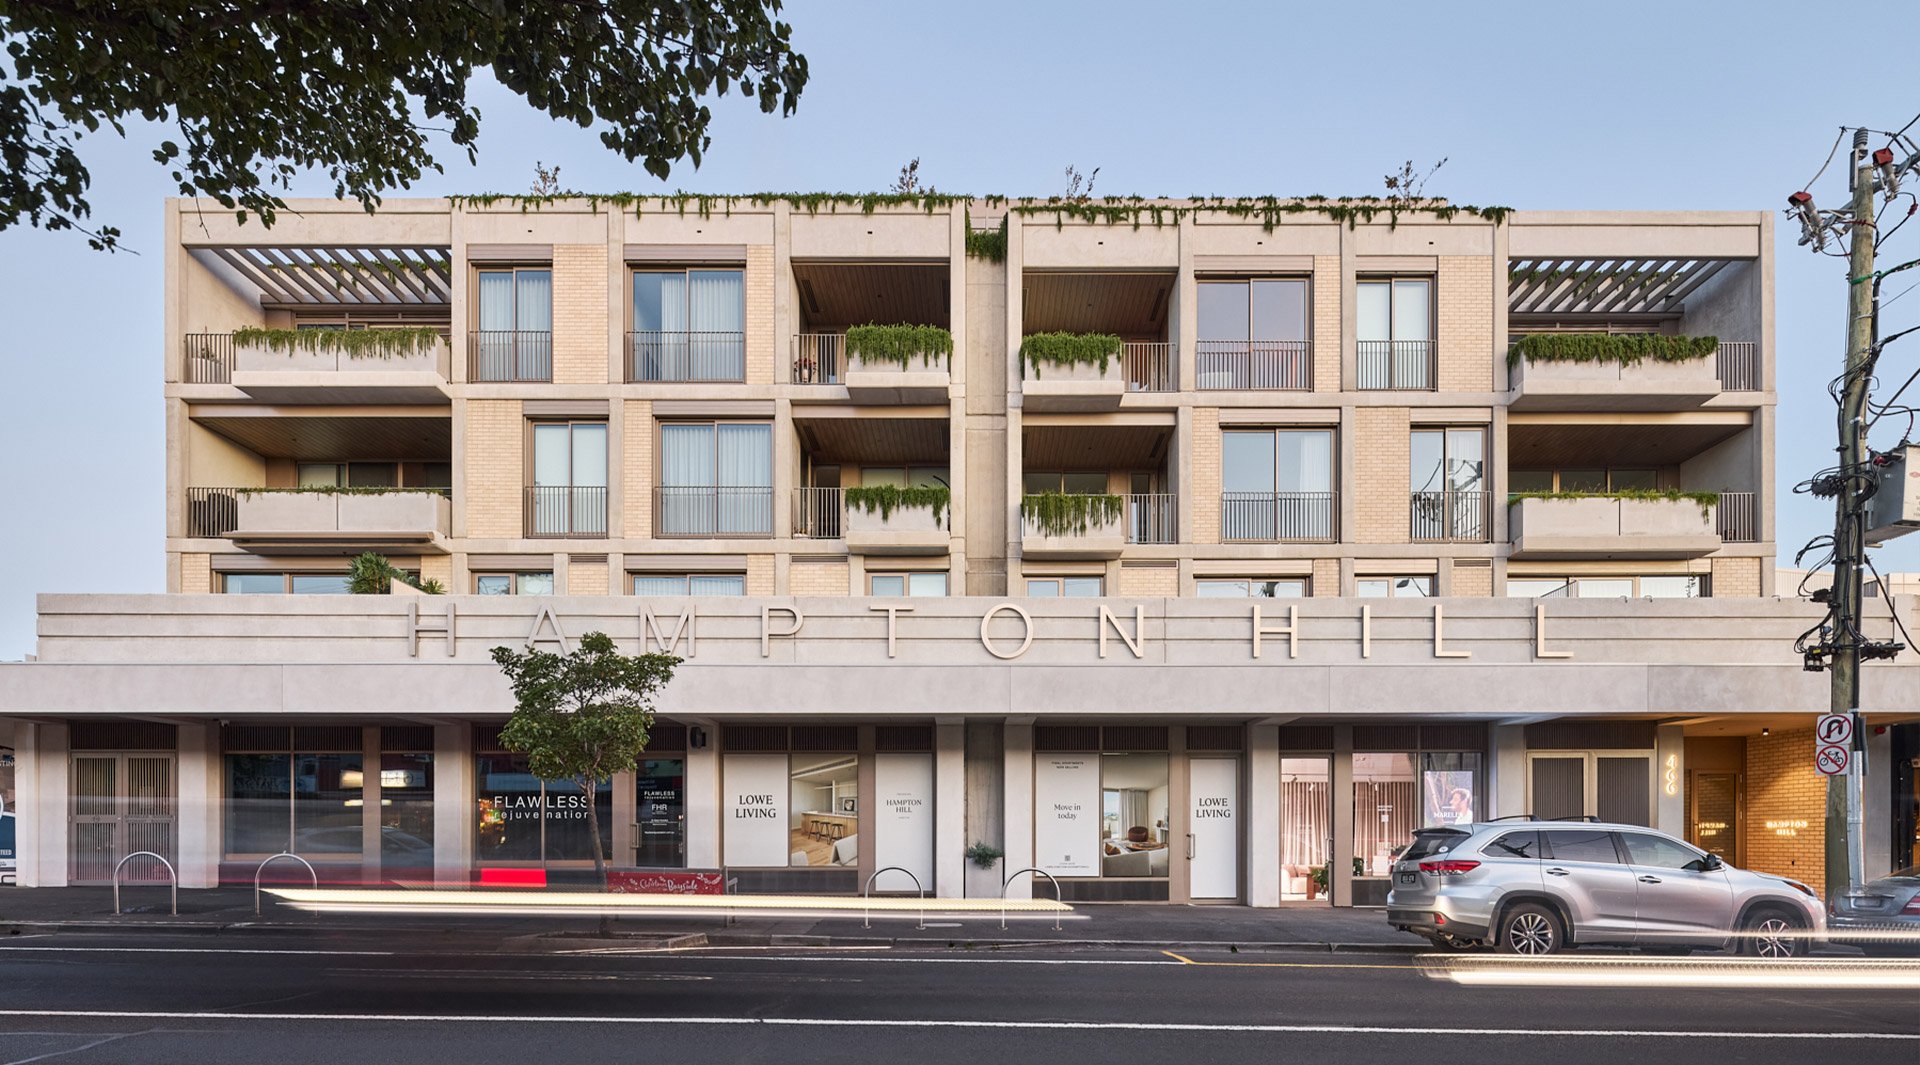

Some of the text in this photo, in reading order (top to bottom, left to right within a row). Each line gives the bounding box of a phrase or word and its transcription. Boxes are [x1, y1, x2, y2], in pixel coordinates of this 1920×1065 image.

[408, 602, 1574, 659] HAMPTON HILL
[1665, 754, 1677, 795] 466
[739, 794, 774, 805] LOWE
[1199, 797, 1228, 807] LOWE
[1054, 802, 1081, 811] Move in
[735, 808, 776, 819] LIVING
[1057, 811, 1077, 821] today
[1196, 808, 1231, 818] LIVING
